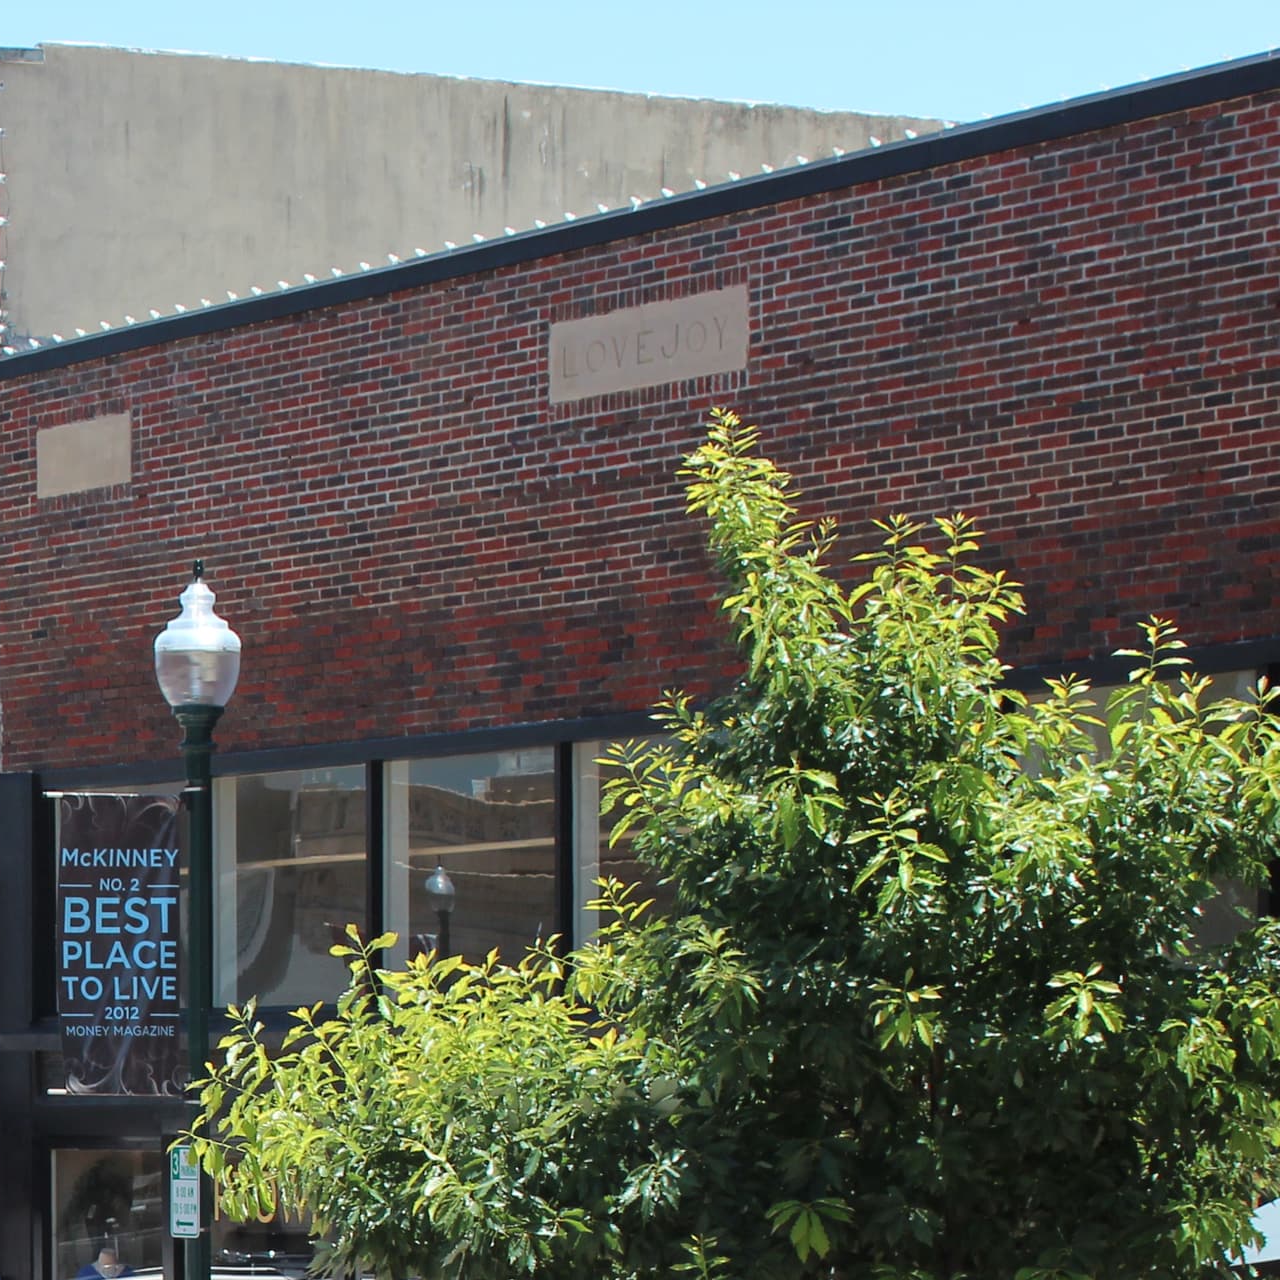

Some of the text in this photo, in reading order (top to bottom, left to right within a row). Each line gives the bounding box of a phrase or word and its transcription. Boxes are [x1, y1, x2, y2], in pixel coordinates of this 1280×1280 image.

[562, 316, 727, 379] LOVEJOY
[61, 848, 179, 867] McKINNEY
[99, 878, 140, 891] NO. 2
[64, 897, 176, 934] BEST
[62, 941, 176, 969] PLACE
[61, 976, 176, 1001] TO LIVE
[104, 1007, 139, 1020] 2012
[66, 1025, 175, 1037] MONEY MAGAZINE
[172, 1153, 179, 1175] 3
